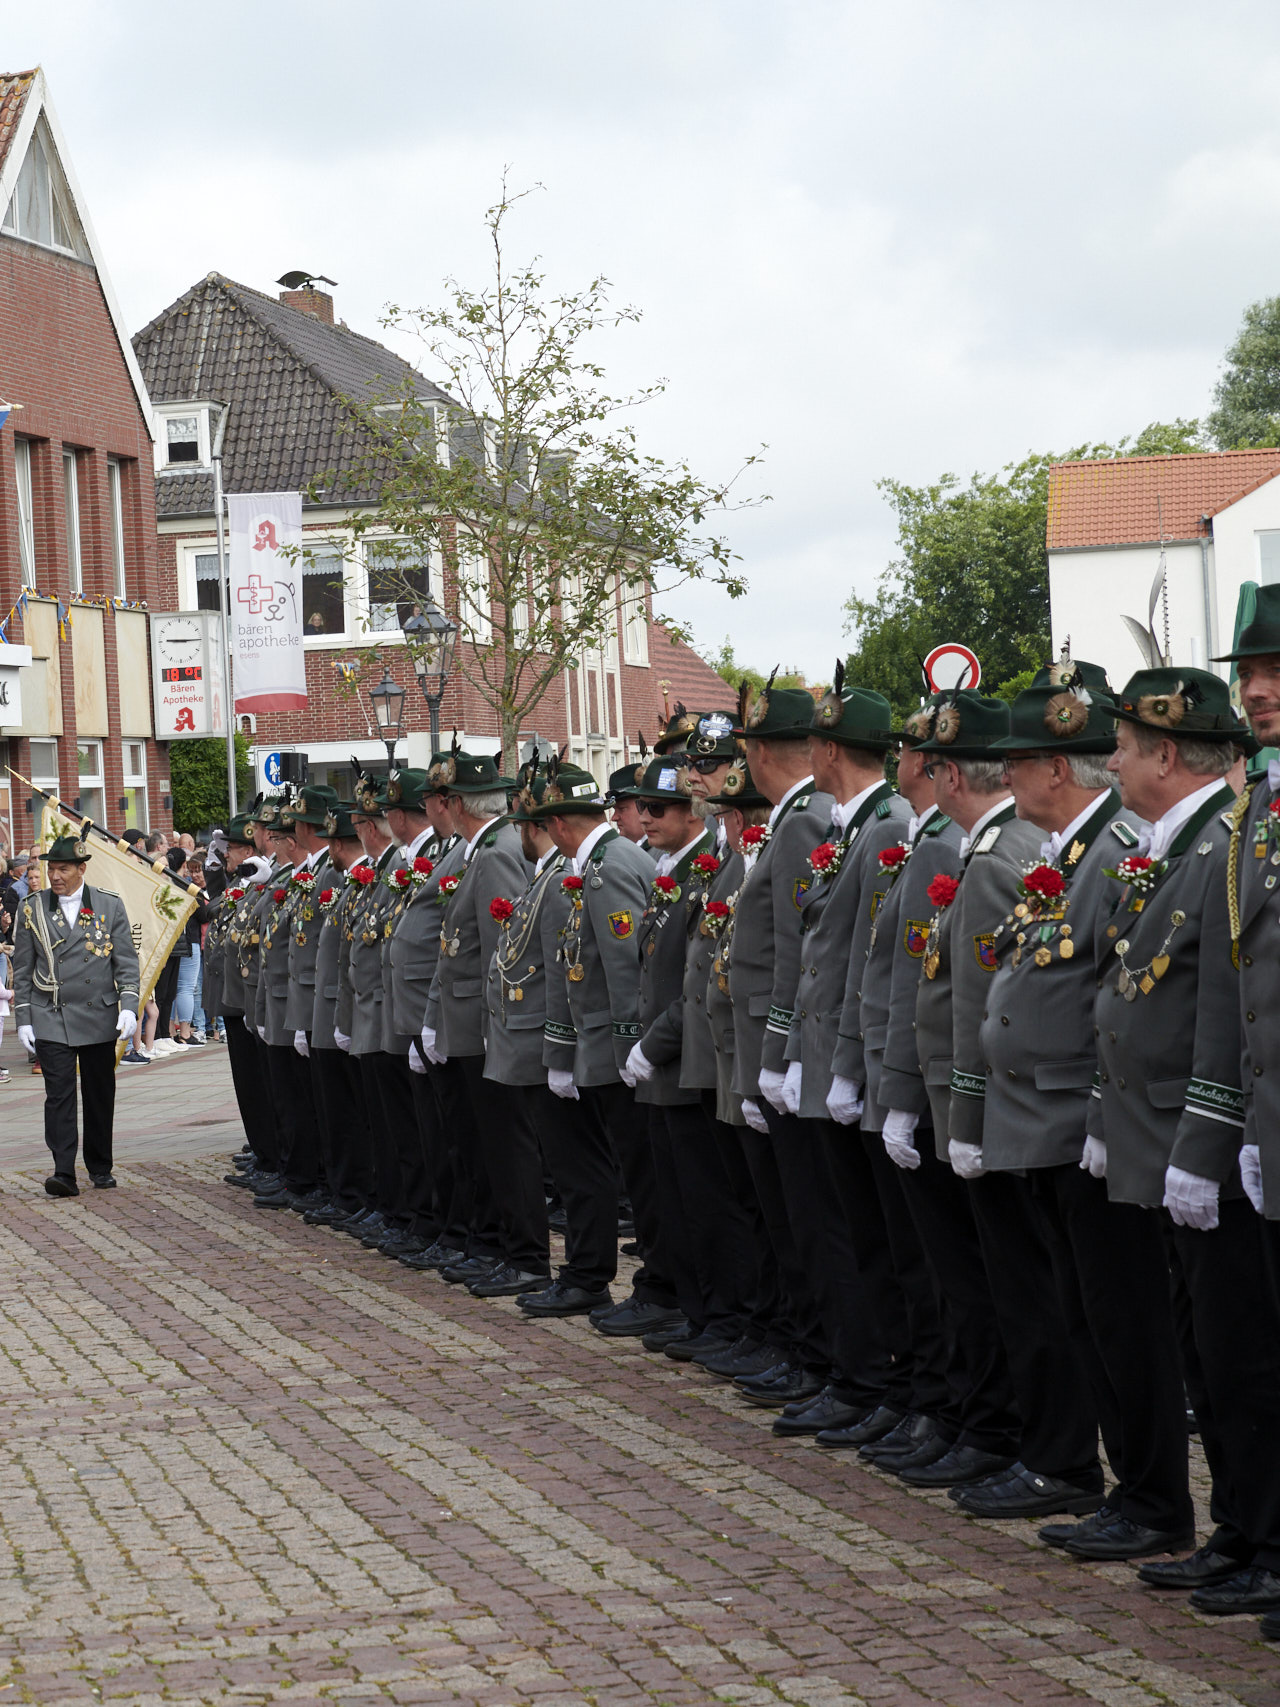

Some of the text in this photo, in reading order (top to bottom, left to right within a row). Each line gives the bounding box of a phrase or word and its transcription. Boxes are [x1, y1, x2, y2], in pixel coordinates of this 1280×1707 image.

[238, 624, 273, 636] bären
[239, 634, 300, 651] apotheke
[239, 651, 260, 660] esens
[166, 668, 180, 681] 18
[170, 684, 195, 693] Bären
[163, 695, 204, 705] Apotheke
